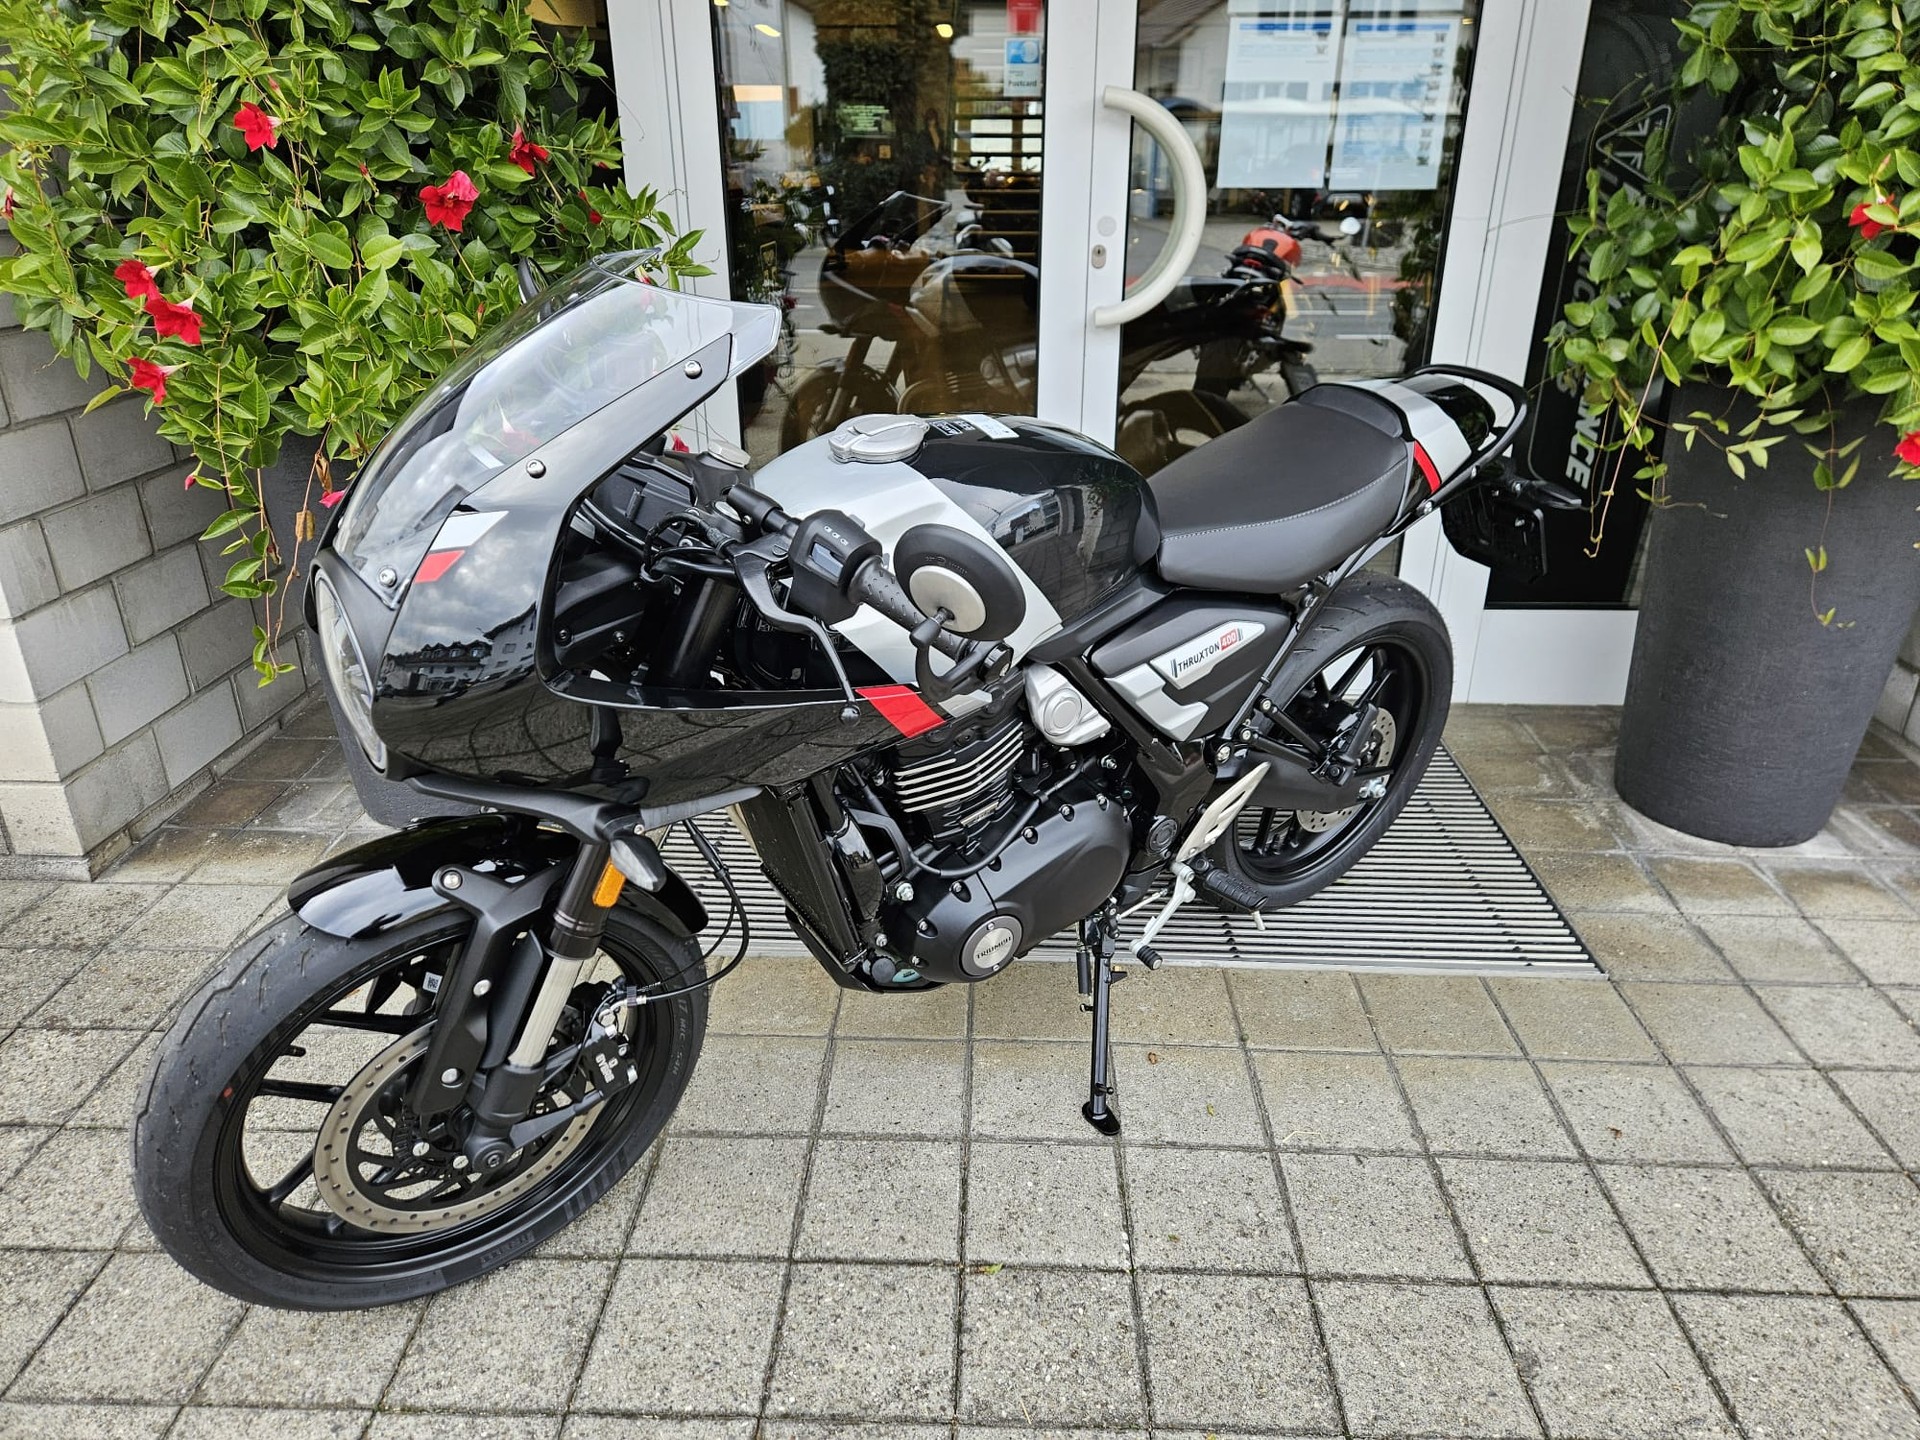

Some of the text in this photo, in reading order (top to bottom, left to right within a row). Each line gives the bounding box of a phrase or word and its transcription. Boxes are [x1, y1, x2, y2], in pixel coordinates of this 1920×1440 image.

[1008, 80, 1038, 88] Postcard
[1178, 630, 1238, 672] THRUXTON 400
